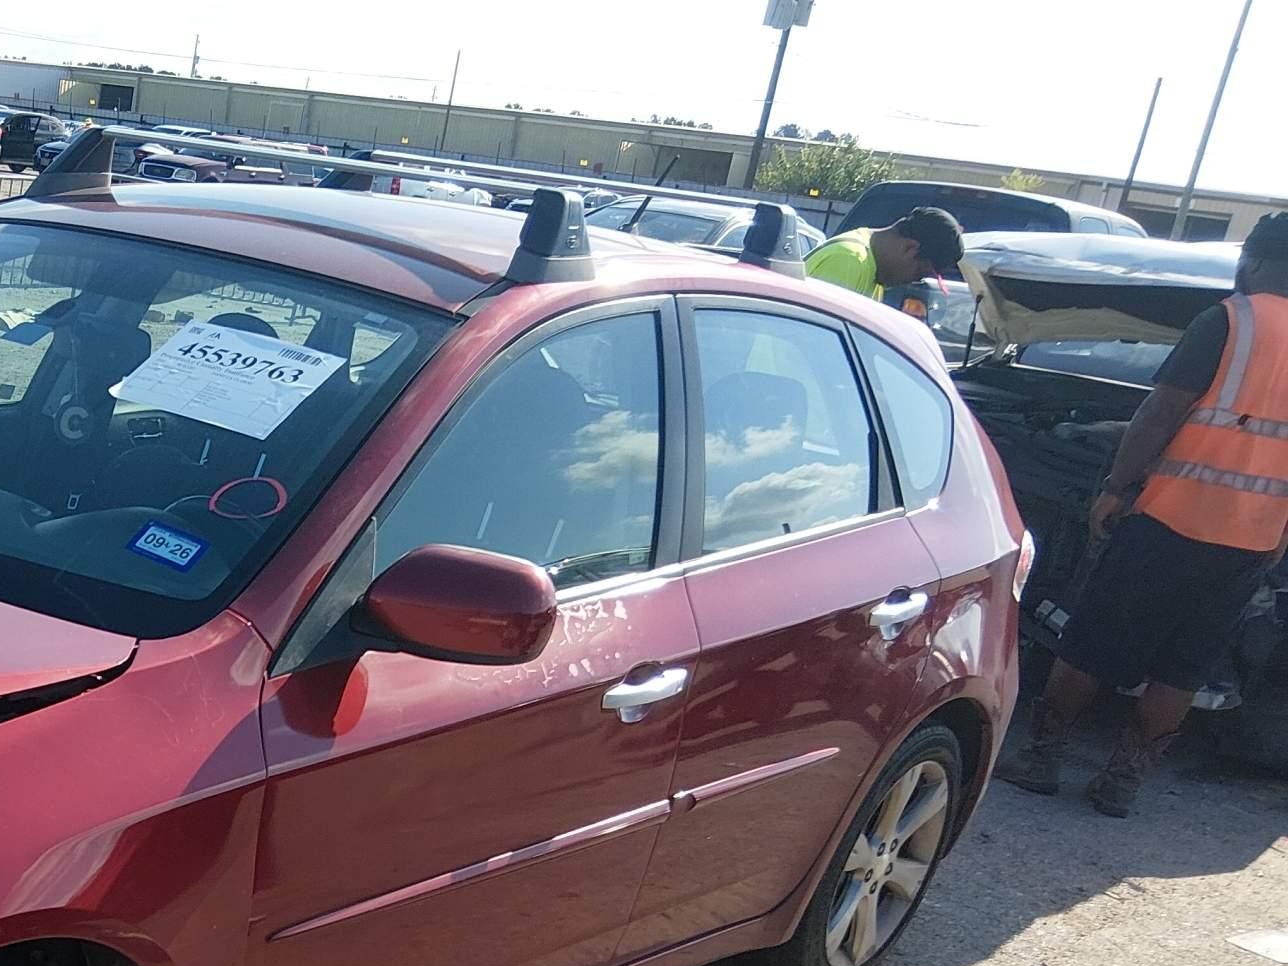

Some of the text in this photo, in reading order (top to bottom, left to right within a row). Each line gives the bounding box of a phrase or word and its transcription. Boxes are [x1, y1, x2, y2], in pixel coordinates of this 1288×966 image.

[178, 341, 304, 383] 45539763
[143, 533, 166, 548] 09
[168, 543, 193, 559] 26
